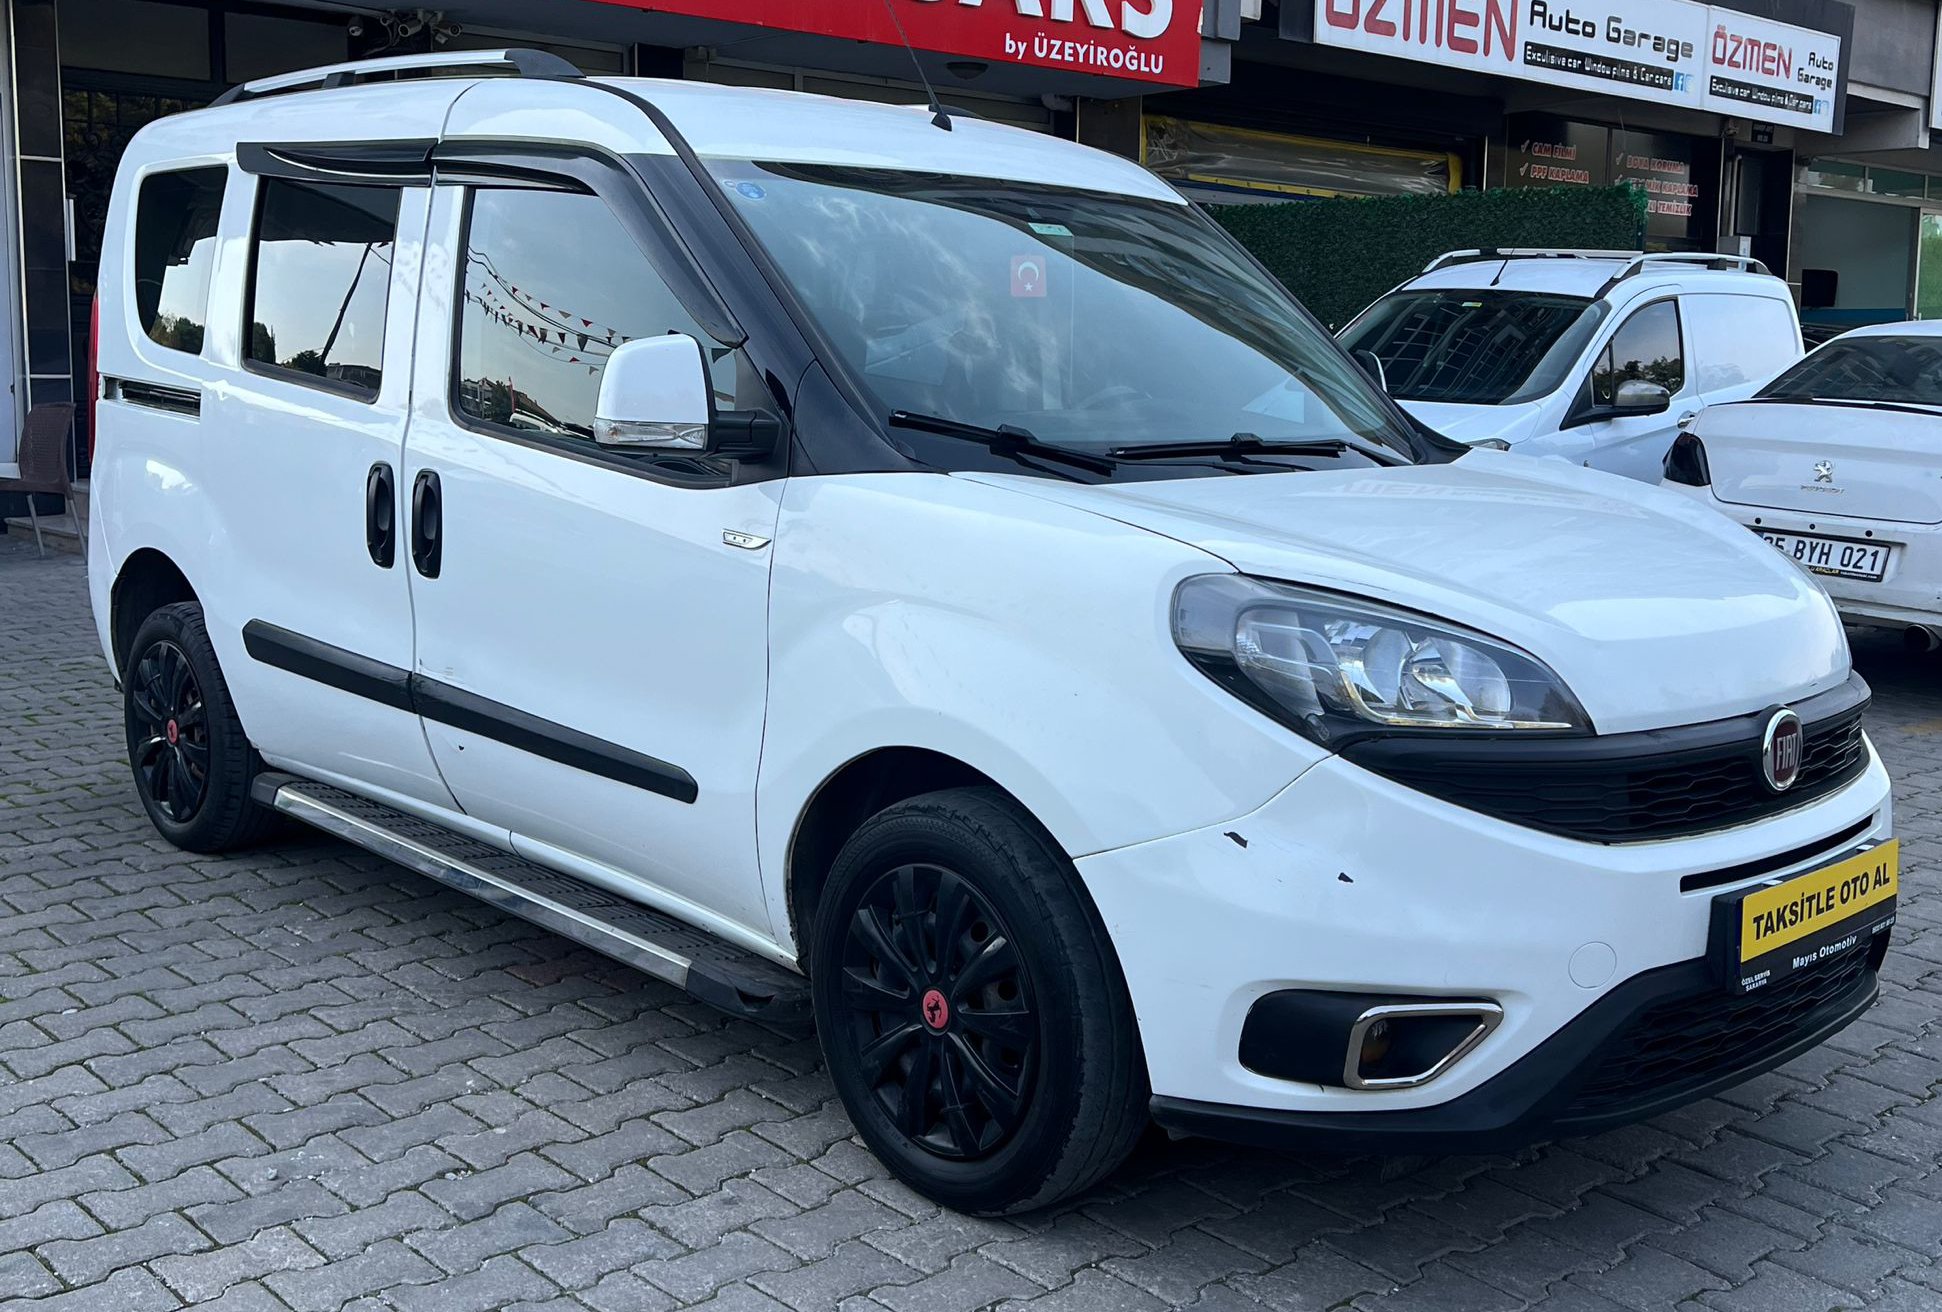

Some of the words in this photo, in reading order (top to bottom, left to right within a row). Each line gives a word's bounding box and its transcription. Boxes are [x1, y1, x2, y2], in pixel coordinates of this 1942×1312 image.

[1529, 0, 1596, 38] Auto
[1606, 15, 1693, 62] Garage
[1005, 32, 1027, 60] by
[1034, 31, 1164, 74] ÜZEYİROĞLU
[1712, 24, 1792, 80] ÖZMEN
[1808, 51, 1833, 71] Auto
[1797, 67, 1832, 91] Garage
[1530, 164, 1548, 179] PPF
[1548, 166, 1590, 185] KAPLAMA
[1658, 199, 1692, 217] TEMİZLİK
[1793, 539, 1832, 566] BYH
[1840, 545, 1880, 572] 021
[1775, 732, 1798, 771] FIAT
[1752, 886, 1836, 941] TAKSİTLE
[1840, 871, 1869, 905] OTO
[1872, 862, 1891, 891] AL
[1792, 951, 1818, 970] Mayıs
[1819, 935, 1857, 958] Otomotiv
